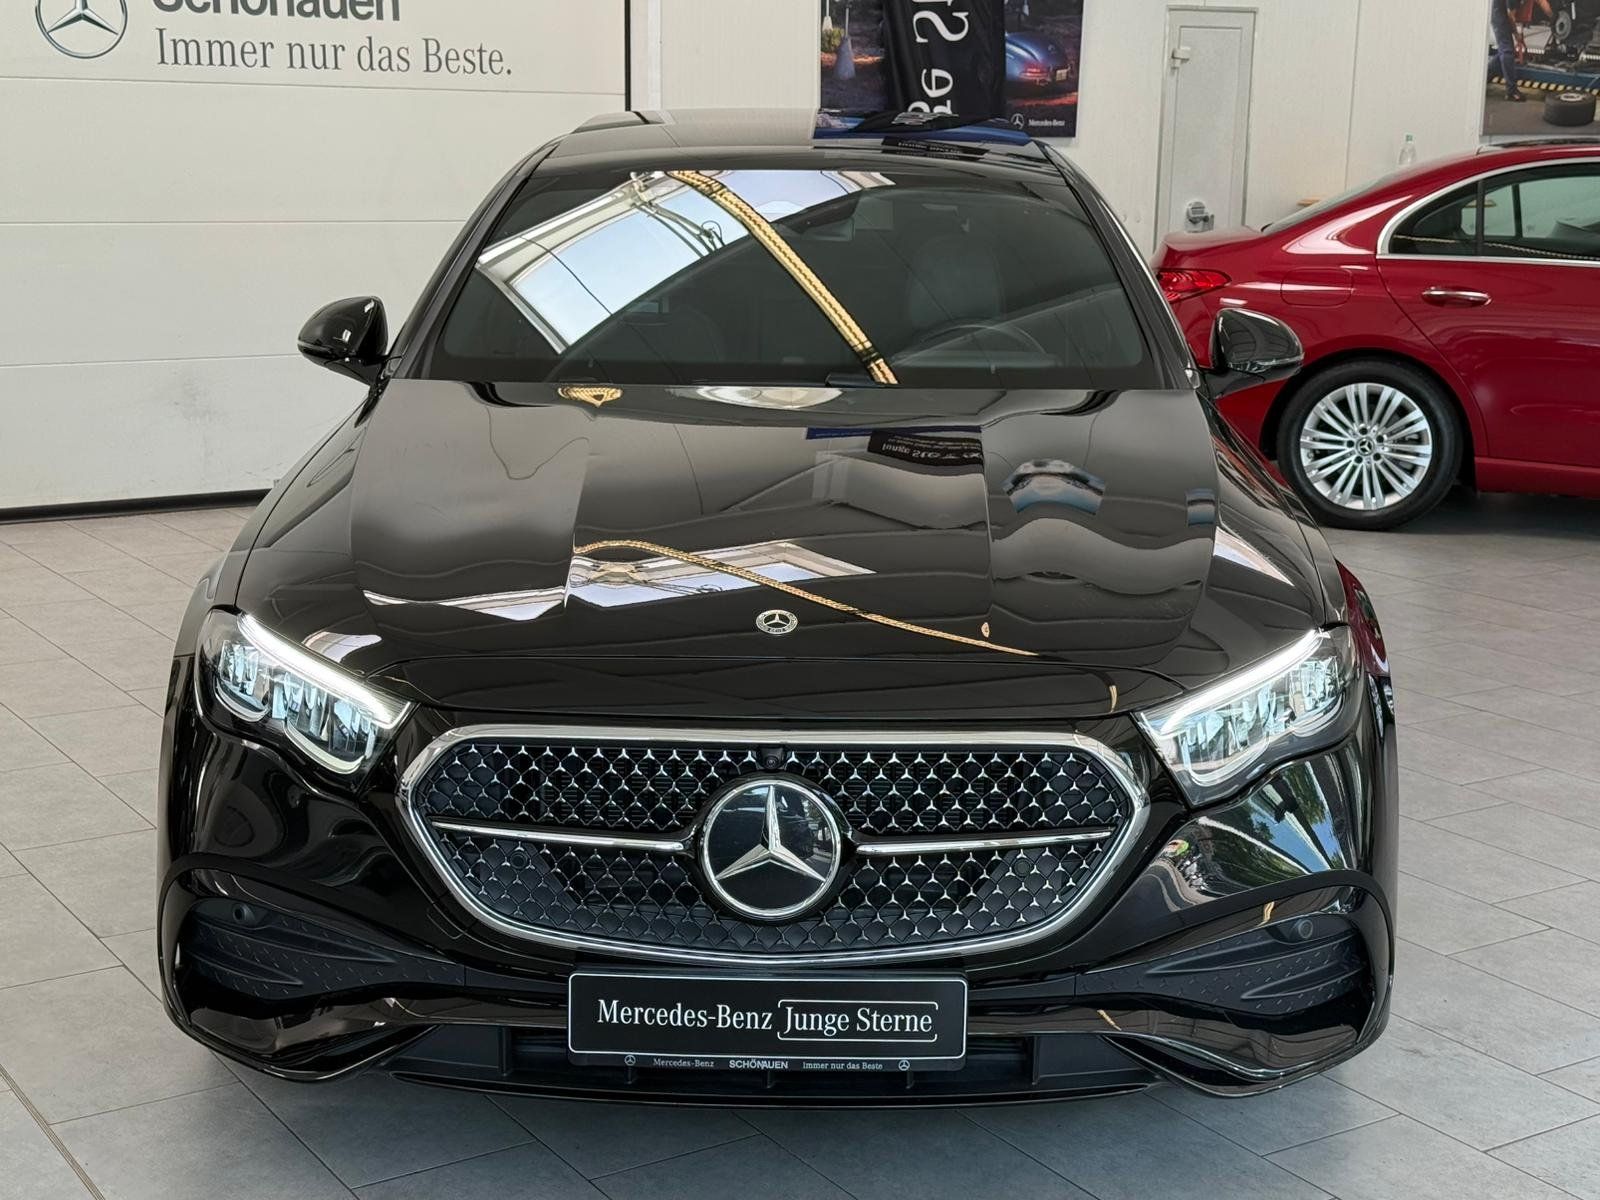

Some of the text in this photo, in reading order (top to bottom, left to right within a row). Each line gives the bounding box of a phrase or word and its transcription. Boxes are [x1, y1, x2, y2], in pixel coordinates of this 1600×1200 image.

[155, 27, 512, 75] Immer nur das Beste.
[597, 999, 933, 1037] Mercedes-Benz Junge Sterne
[653, 1058, 715, 1068] Mercedes-Benz
[729, 1058, 789, 1069] SCHÖNAUEN
[803, 1061, 829, 1070] Immer
[831, 1062, 845, 1070] nur
[846, 1061, 860, 1070] das
